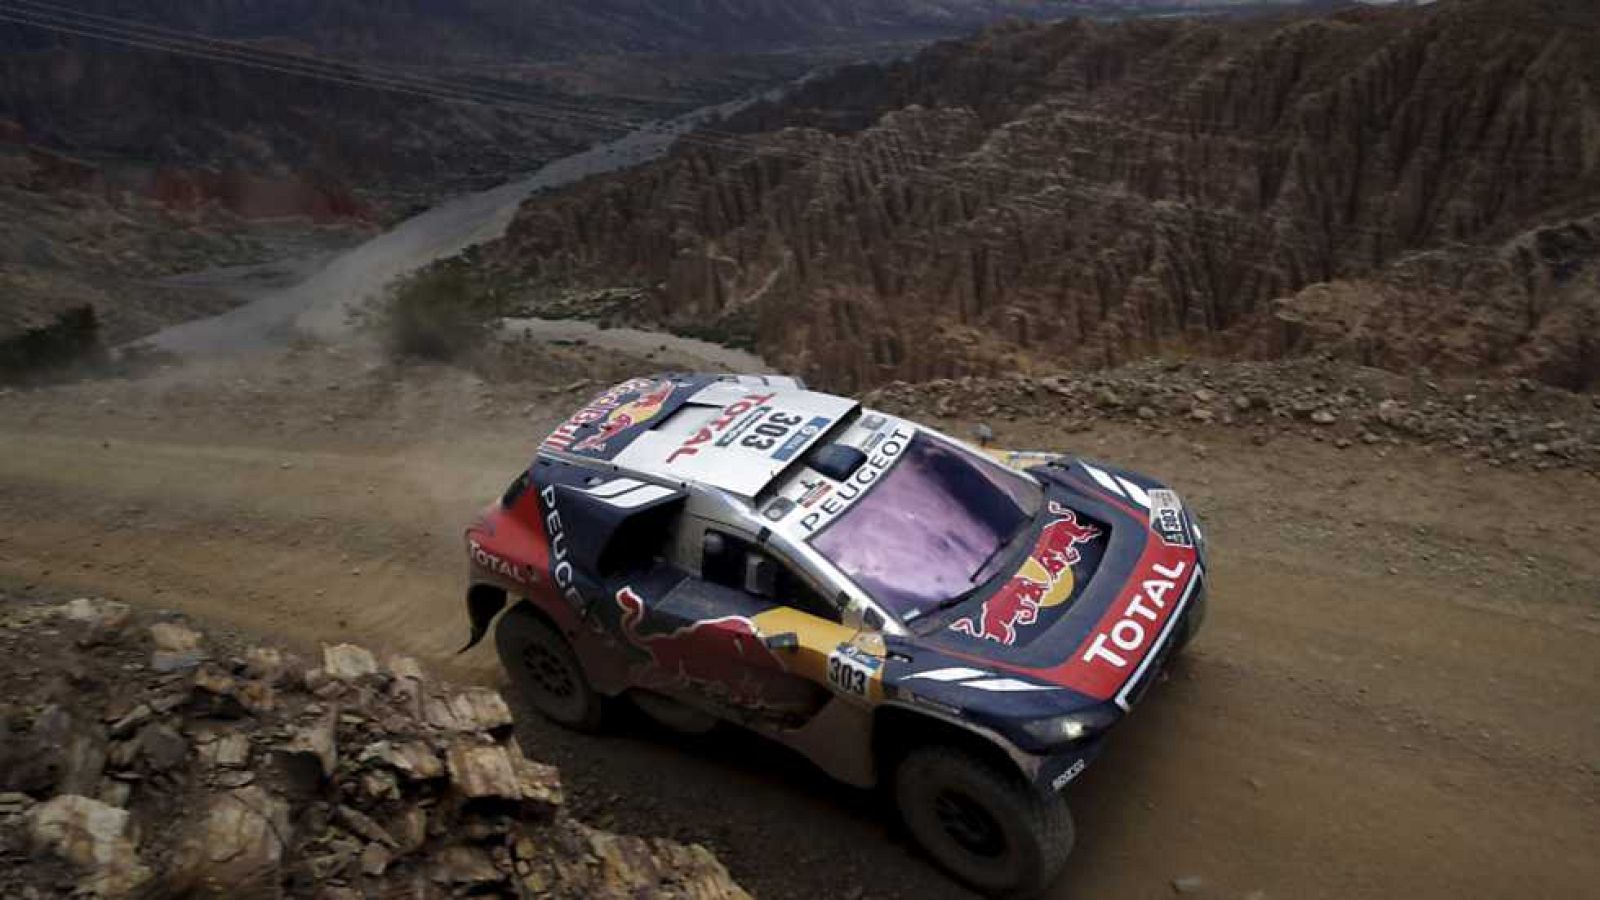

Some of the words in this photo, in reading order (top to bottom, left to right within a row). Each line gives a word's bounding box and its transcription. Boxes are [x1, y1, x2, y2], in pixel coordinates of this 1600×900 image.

[665, 392, 775, 464] TOTAL
[740, 412, 802, 450] 303
[800, 428, 908, 531] PEUGEOT
[1161, 509, 1180, 530] 303
[469, 540, 527, 583] TOTAL
[1083, 561, 1186, 667] TOTAL
[829, 653, 866, 695] 303
